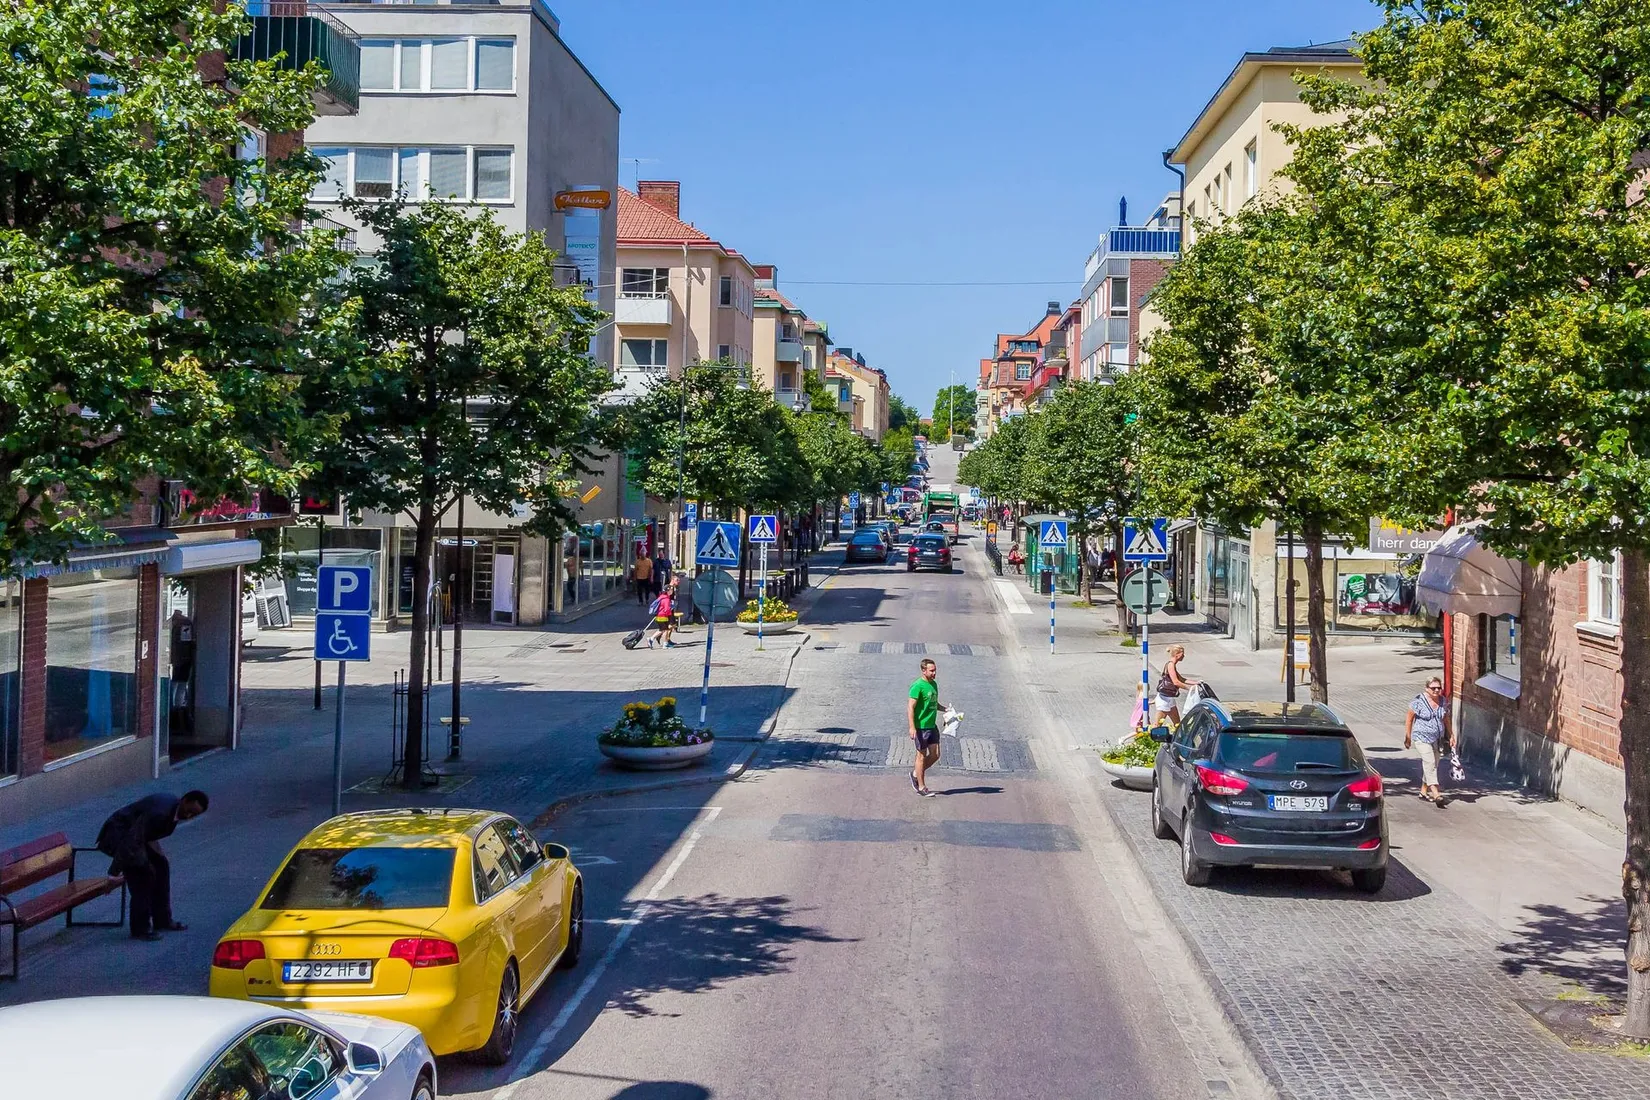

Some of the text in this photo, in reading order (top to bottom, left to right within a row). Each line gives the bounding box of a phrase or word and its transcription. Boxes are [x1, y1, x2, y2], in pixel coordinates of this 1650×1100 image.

[688, 504, 695, 512] P
[1377, 537, 1405, 548] herr
[333, 570, 359, 607] P
[1275, 797, 1325, 808] MPE 579
[293, 963, 332, 978] 2292
